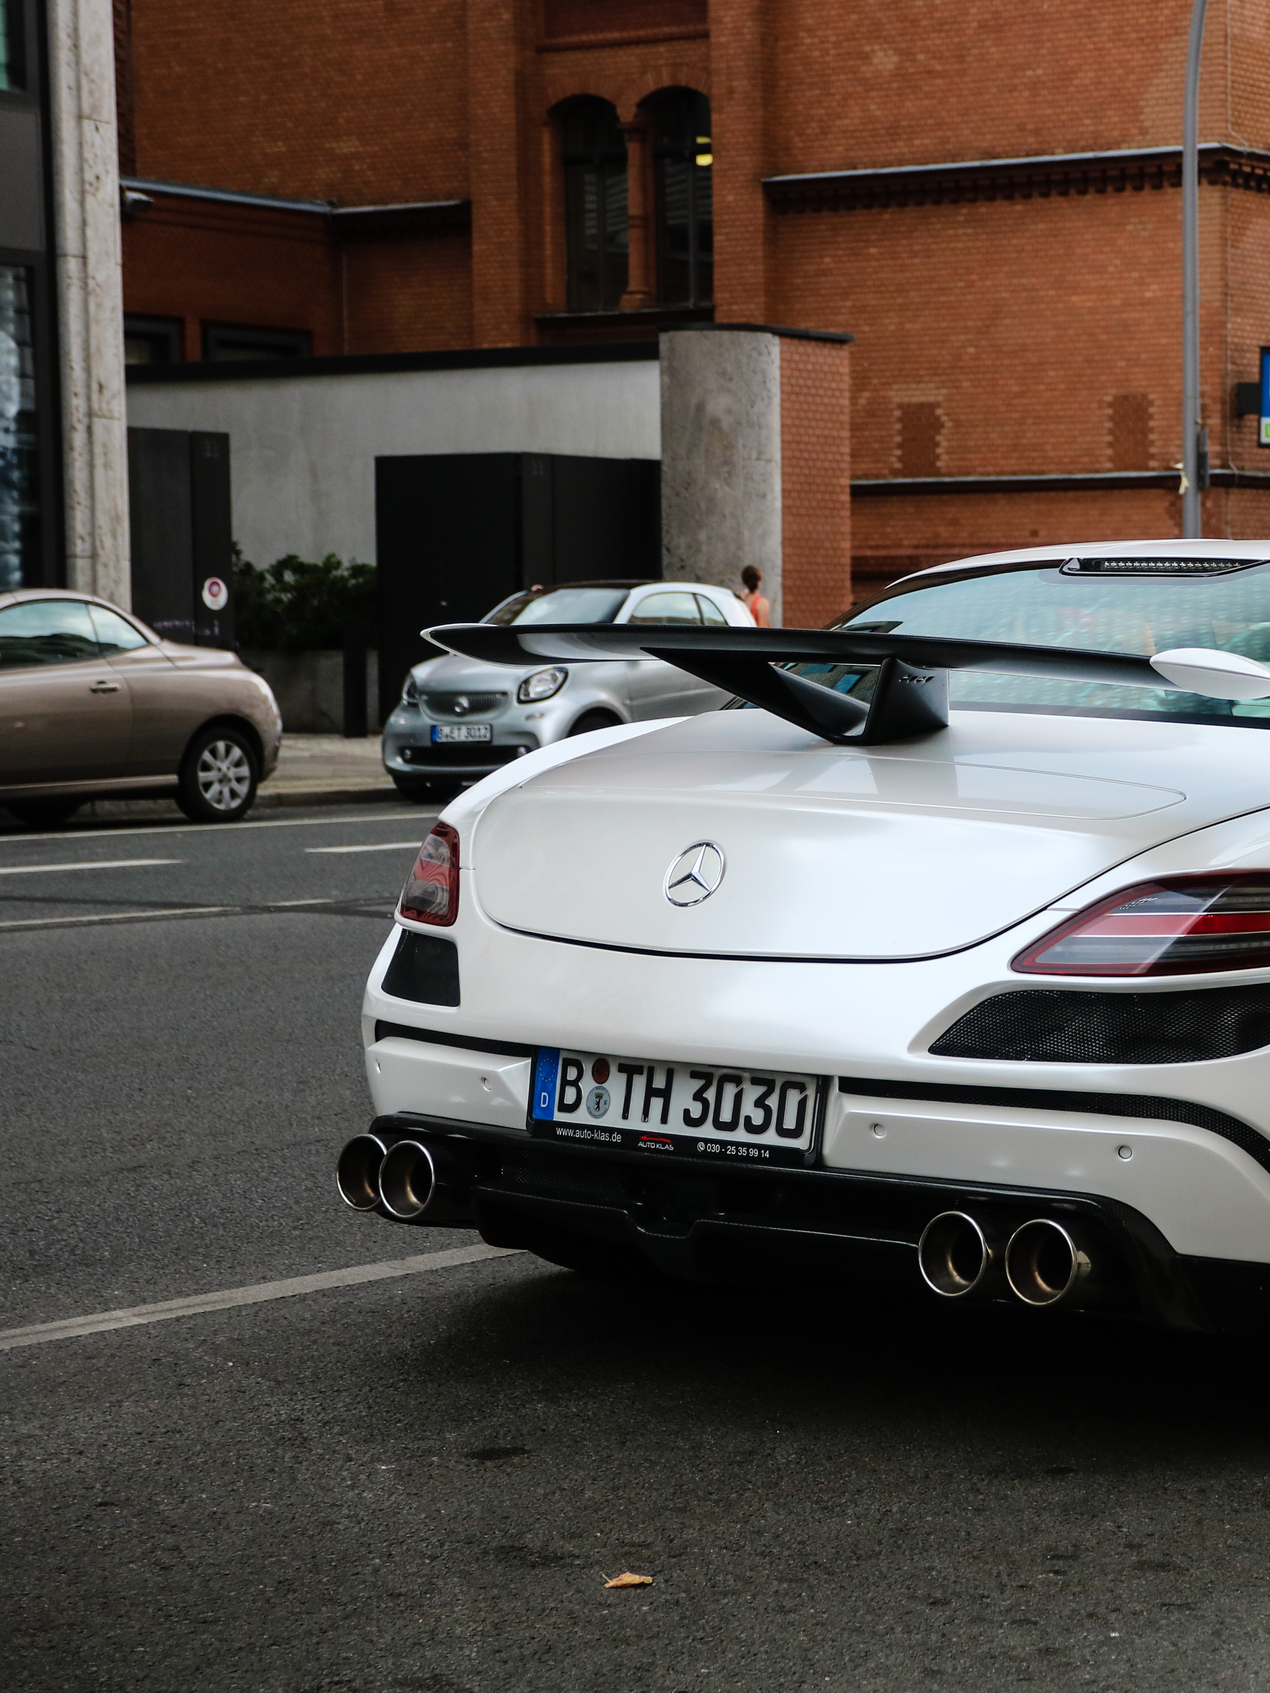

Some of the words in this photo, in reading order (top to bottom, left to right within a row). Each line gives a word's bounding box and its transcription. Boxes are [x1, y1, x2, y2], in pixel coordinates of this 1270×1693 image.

[540, 1092, 549, 1108] D
[557, 1057, 584, 1113] B
[618, 1063, 674, 1125] TH
[682, 1070, 808, 1139] 3030
[555, 1127, 622, 1143] www.auto-klas.de
[638, 1141, 656, 1149] AUTO
[656, 1142, 674, 1151] KLAS
[706, 1143, 720, 1153] 030
[726, 1145, 736, 1155] 25
[737, 1146, 747, 1156] 35
[749, 1148, 758, 1157] 99
[760, 1149, 769, 1158] 14
